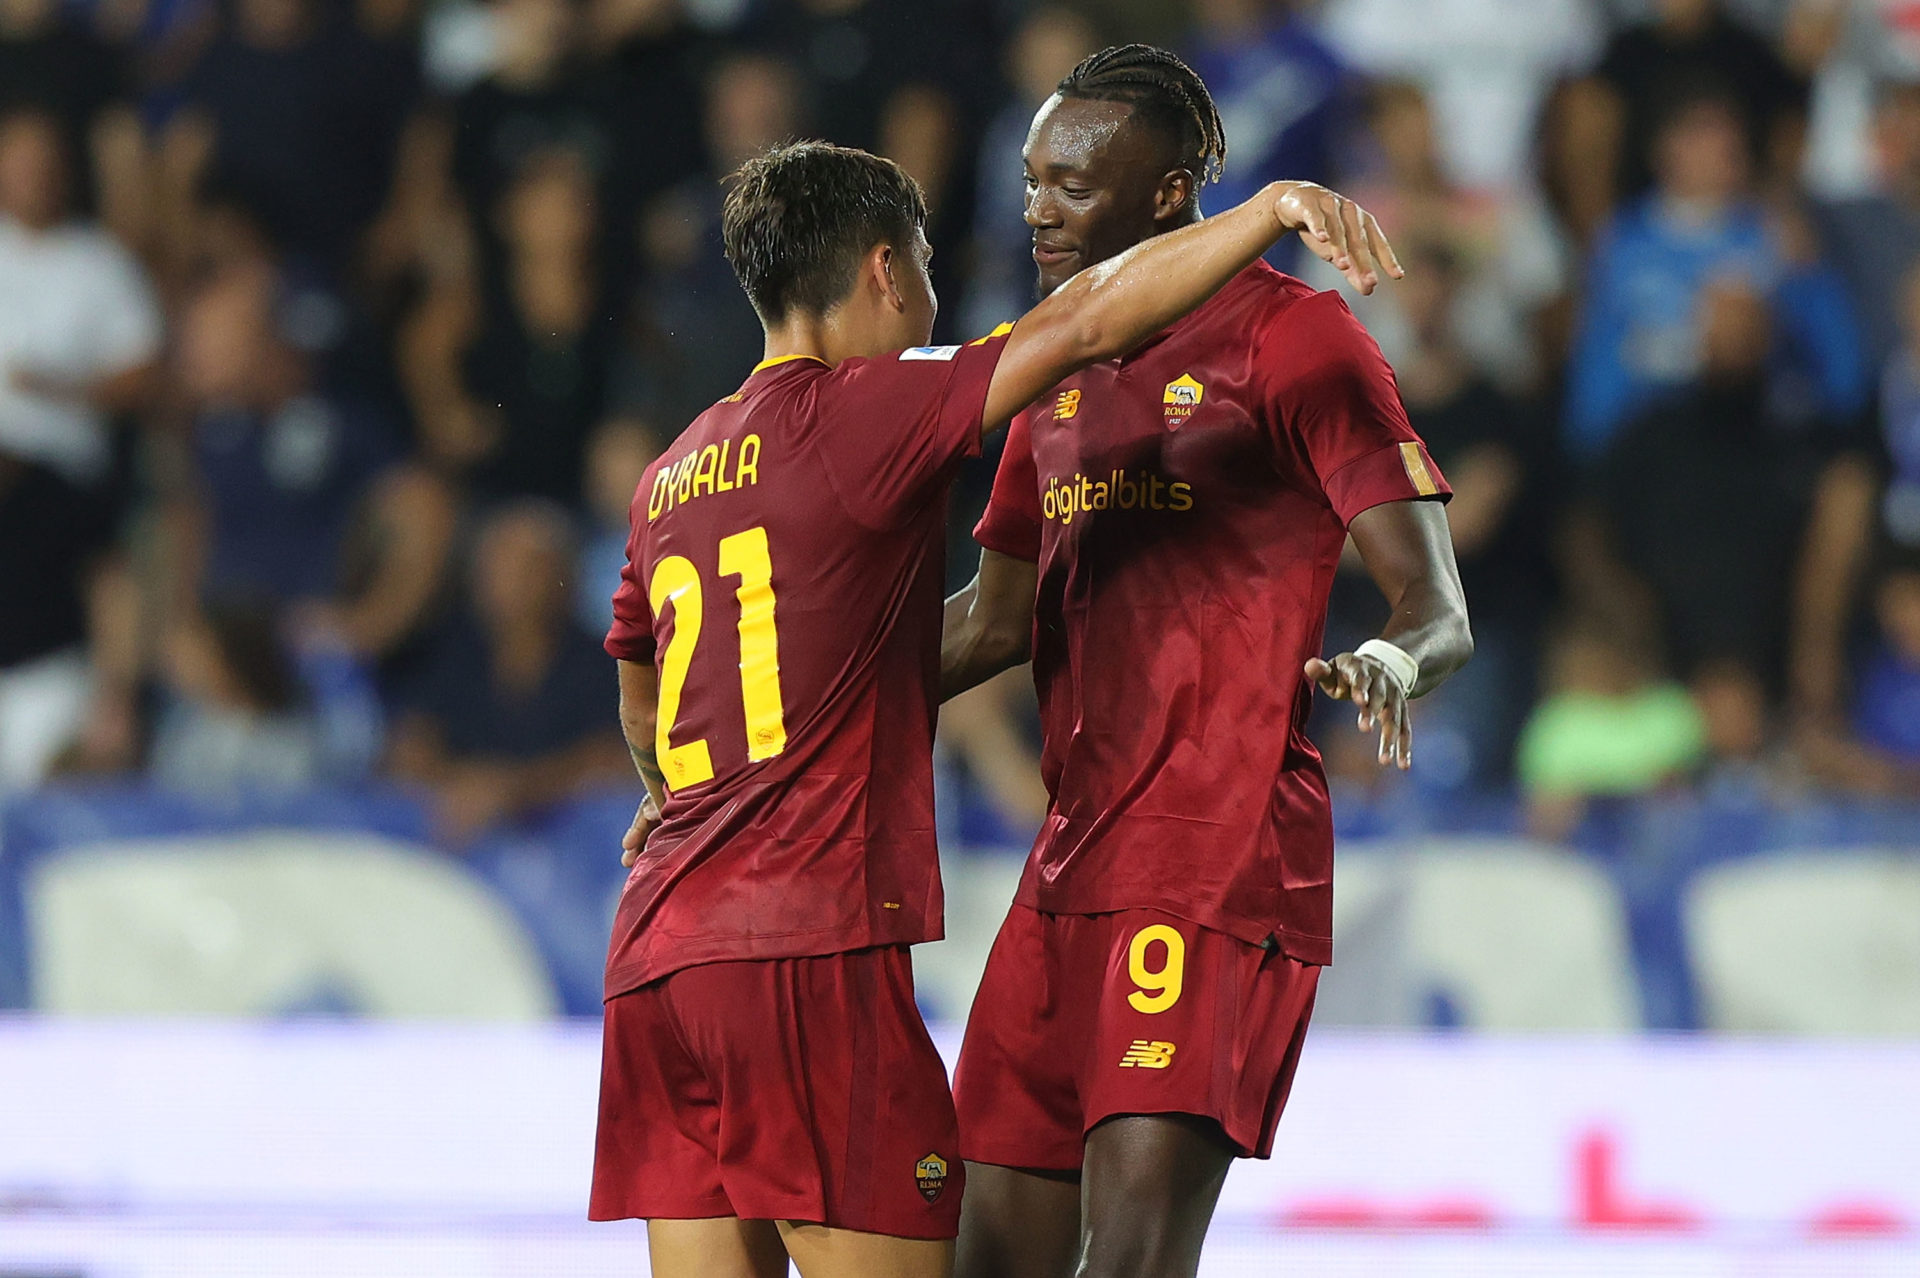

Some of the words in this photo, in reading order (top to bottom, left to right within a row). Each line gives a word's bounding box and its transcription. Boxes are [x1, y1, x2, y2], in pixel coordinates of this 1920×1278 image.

[1164, 407, 1191, 416] ROMA
[648, 434, 761, 523] DYBALA
[1044, 469, 1193, 525] digitalbits
[649, 526, 787, 792] 21
[1127, 924, 1185, 1014] 9
